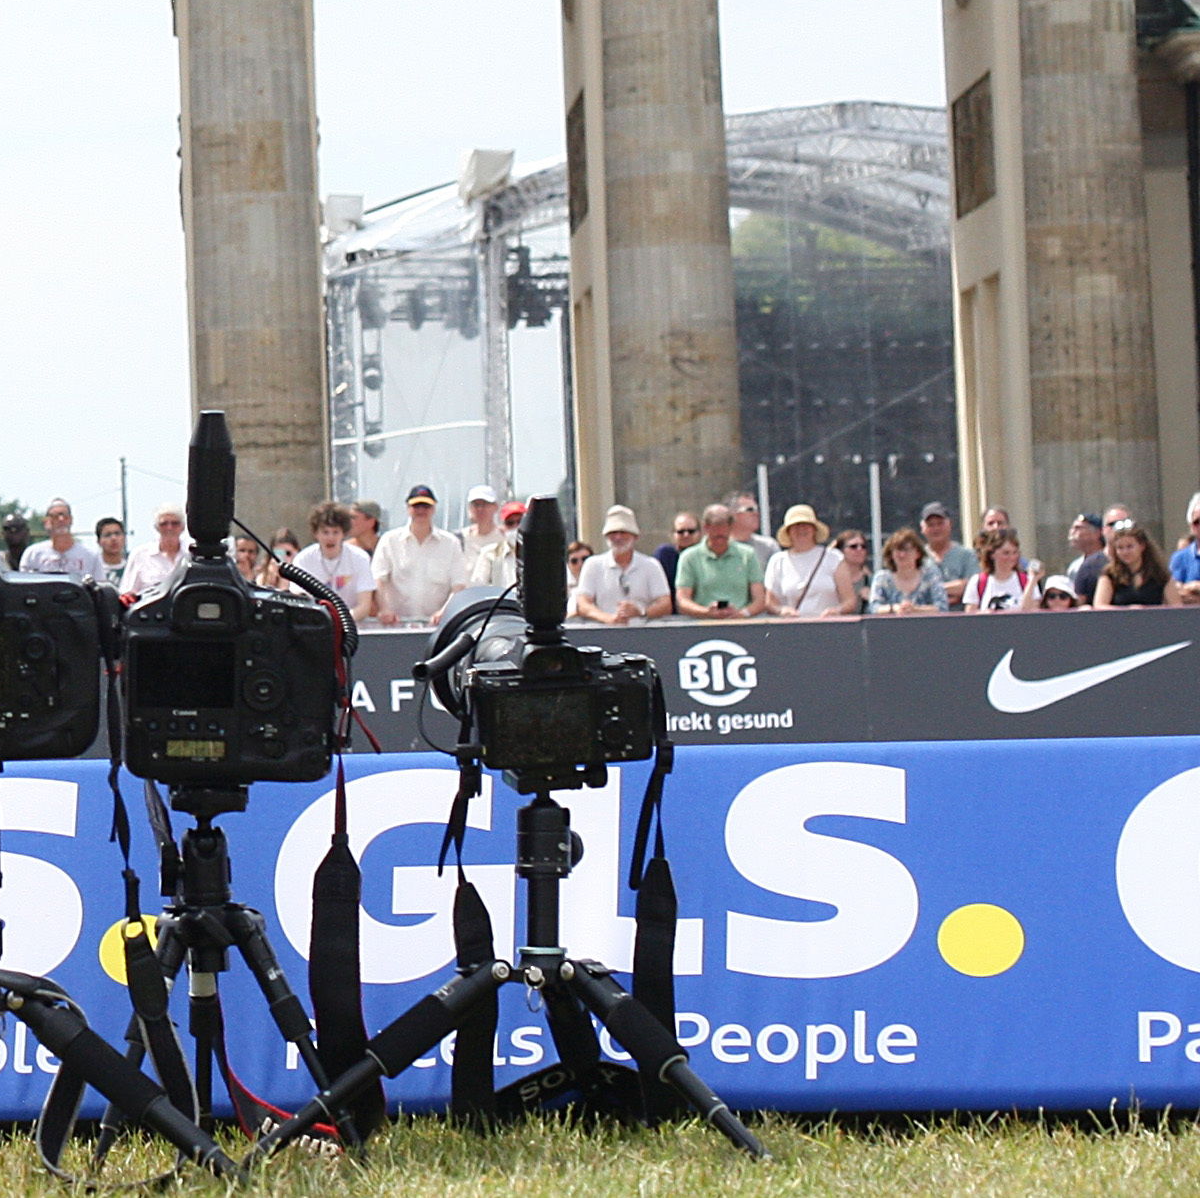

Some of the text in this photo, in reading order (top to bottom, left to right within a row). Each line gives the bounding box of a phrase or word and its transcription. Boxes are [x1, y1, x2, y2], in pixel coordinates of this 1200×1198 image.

[679, 655, 757, 691] BIG
[717, 709, 793, 734] gesund
[676, 1010, 917, 1080] People
[519, 1068, 618, 1102] SOY
